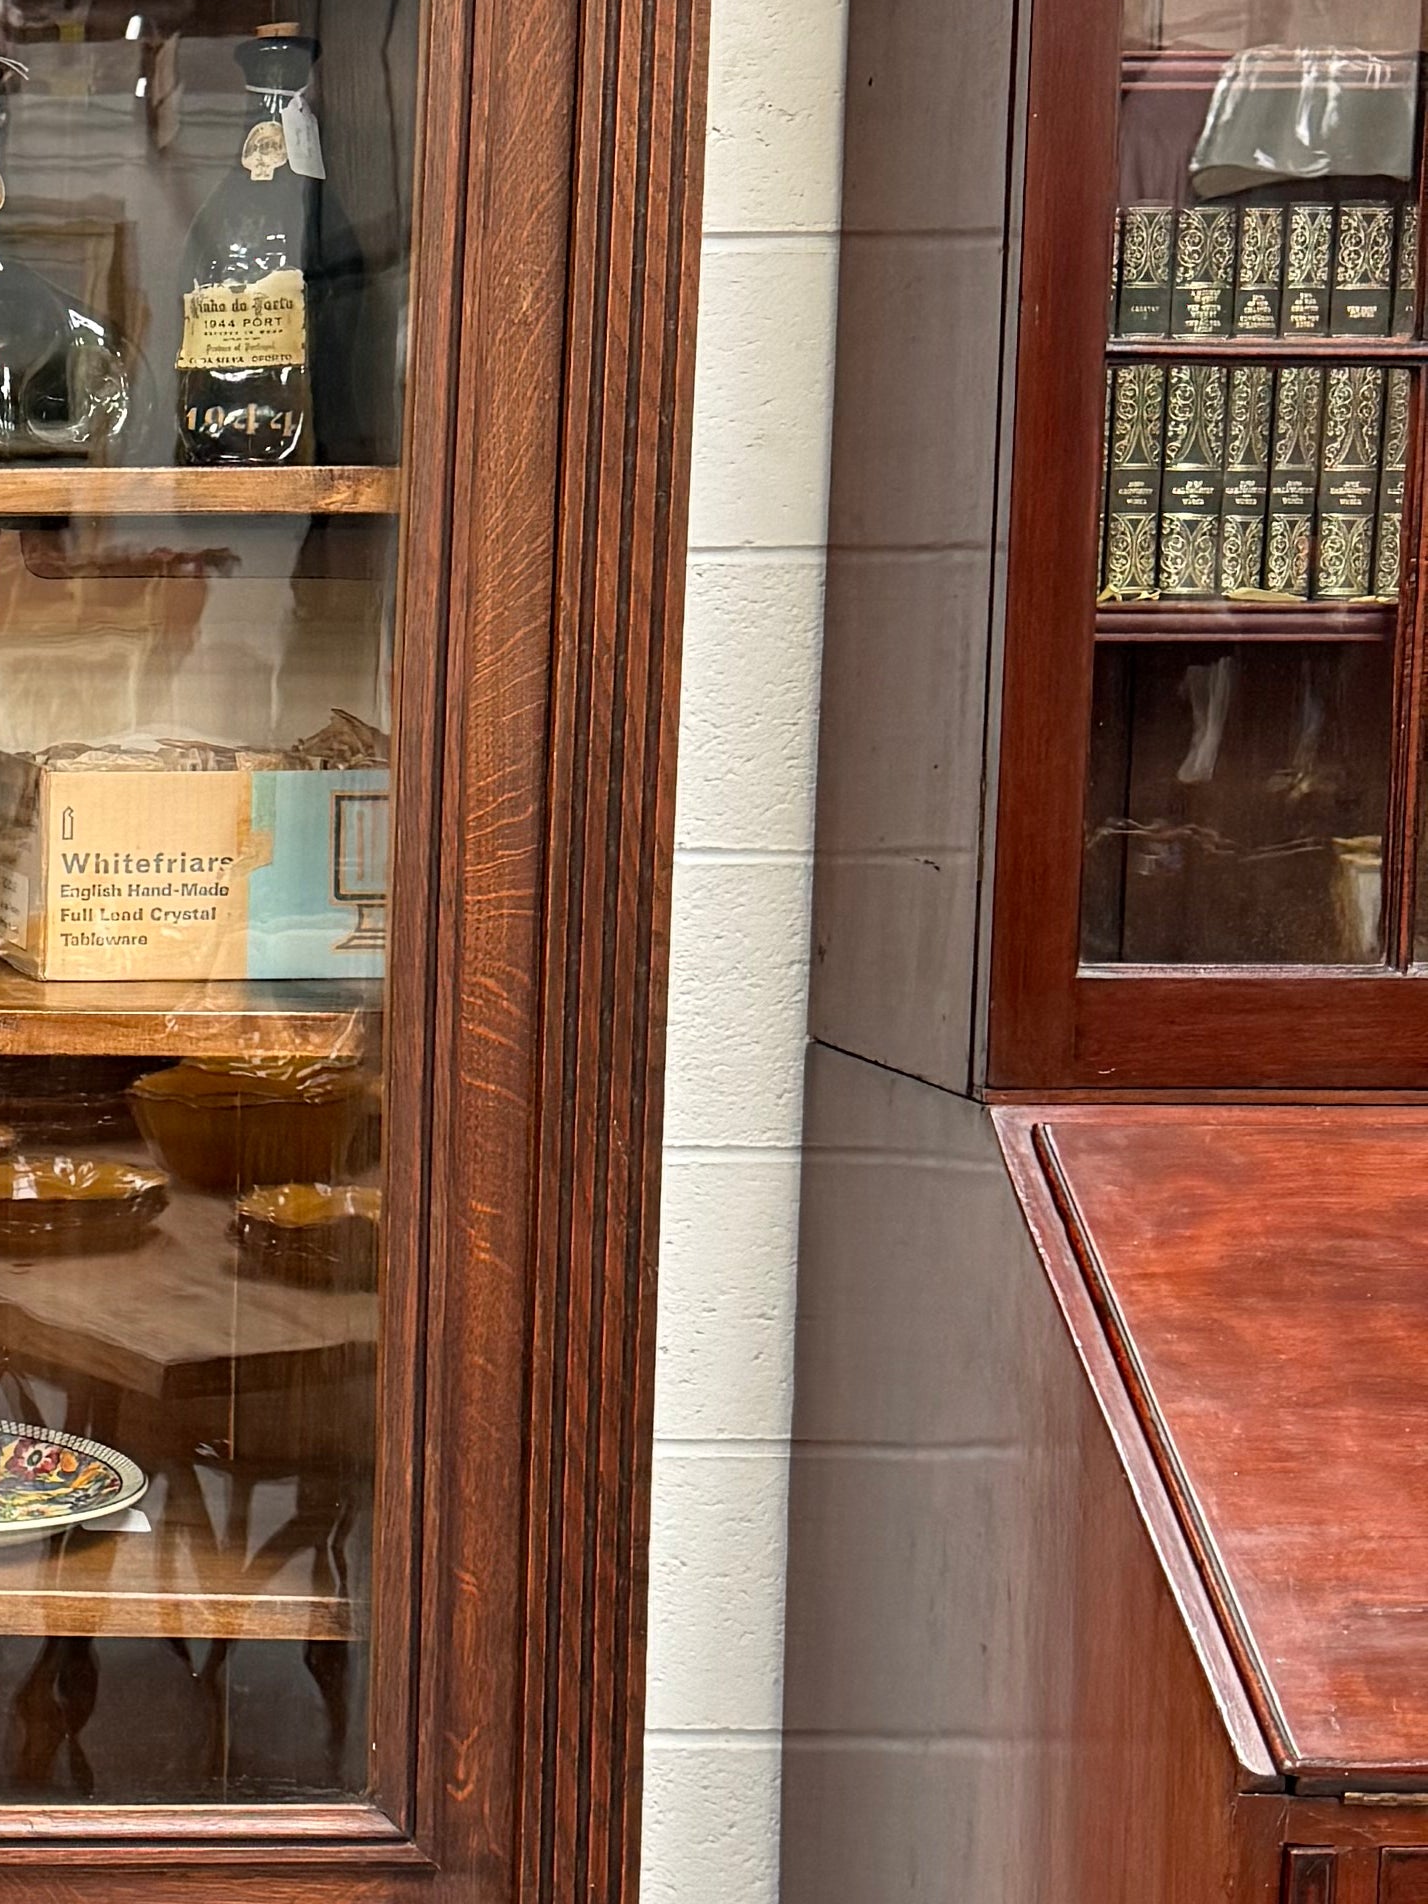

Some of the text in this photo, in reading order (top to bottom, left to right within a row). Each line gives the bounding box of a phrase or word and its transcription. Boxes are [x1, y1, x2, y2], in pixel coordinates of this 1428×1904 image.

[204, 316, 283, 329] 1944 PORT
[61, 852, 234, 875] Whitefriars
[60, 882, 230, 901] English Hand-Made
[60, 906, 217, 924] Full Lead Crystal
[60, 932, 149, 947] Tableware
